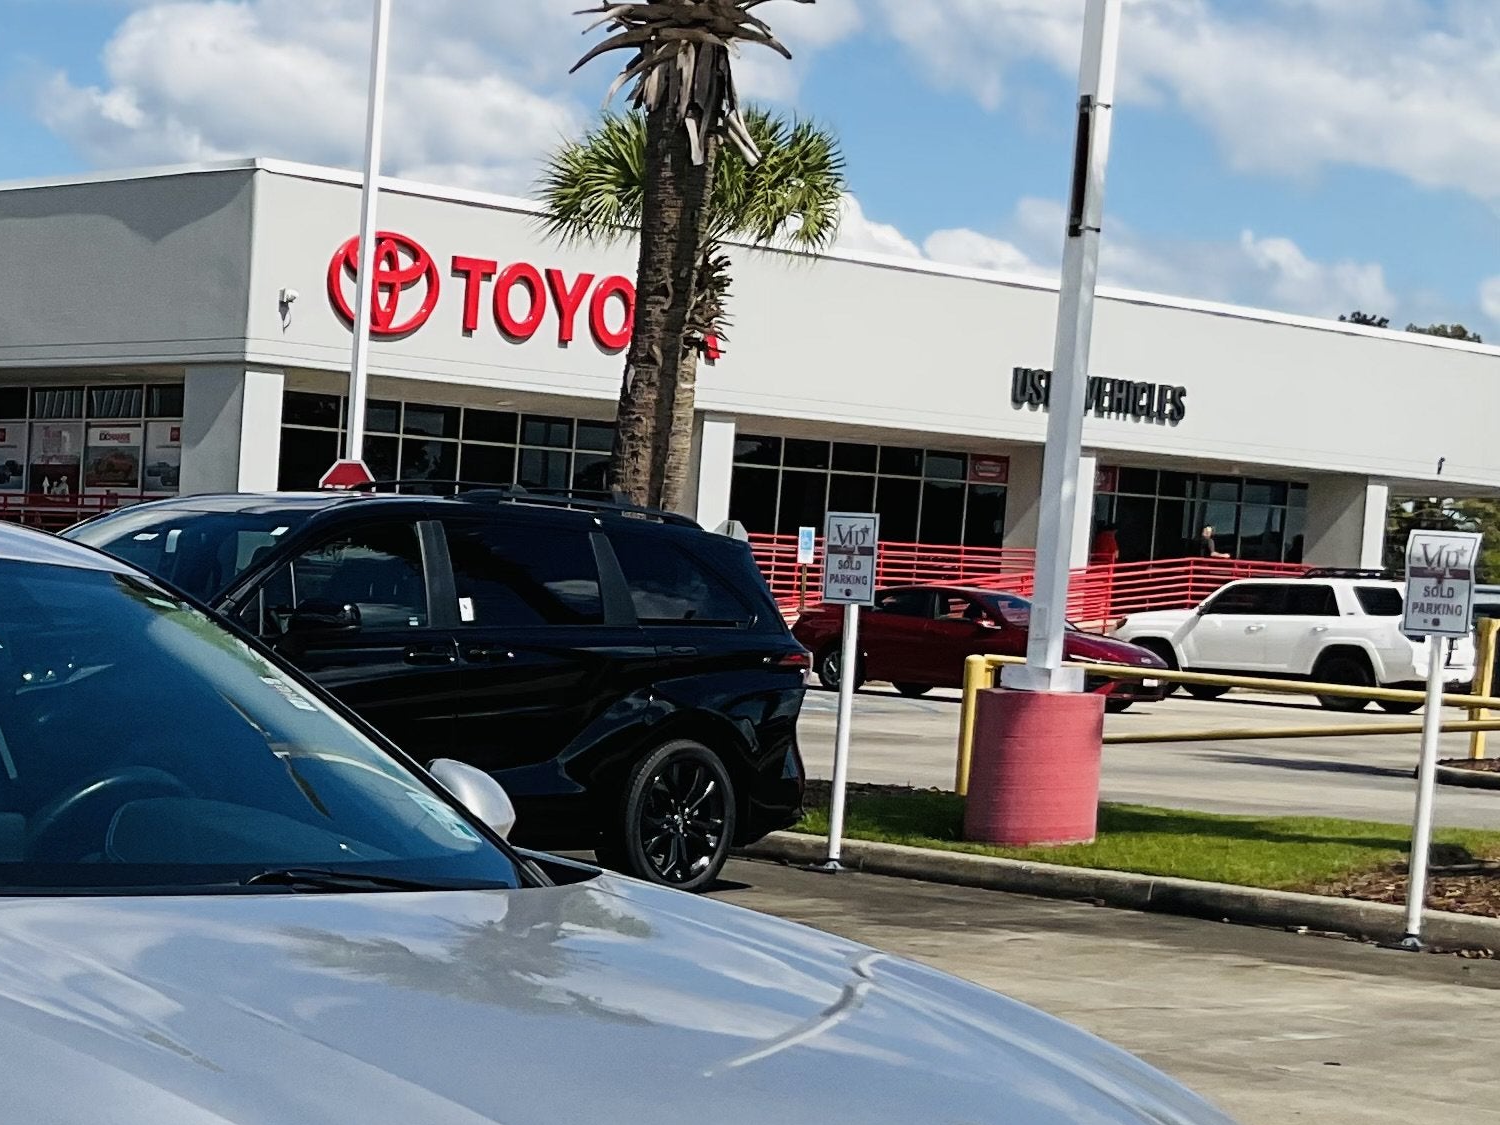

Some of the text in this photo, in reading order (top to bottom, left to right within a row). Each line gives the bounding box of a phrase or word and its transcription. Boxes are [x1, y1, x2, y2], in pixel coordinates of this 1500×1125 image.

[451, 255, 720, 360] TOYO
[838, 560, 861, 570] SOLD
[829, 574, 868, 585] PARKING
[1423, 585, 1454, 598] SOLD
[1411, 602, 1462, 616] PARKING
